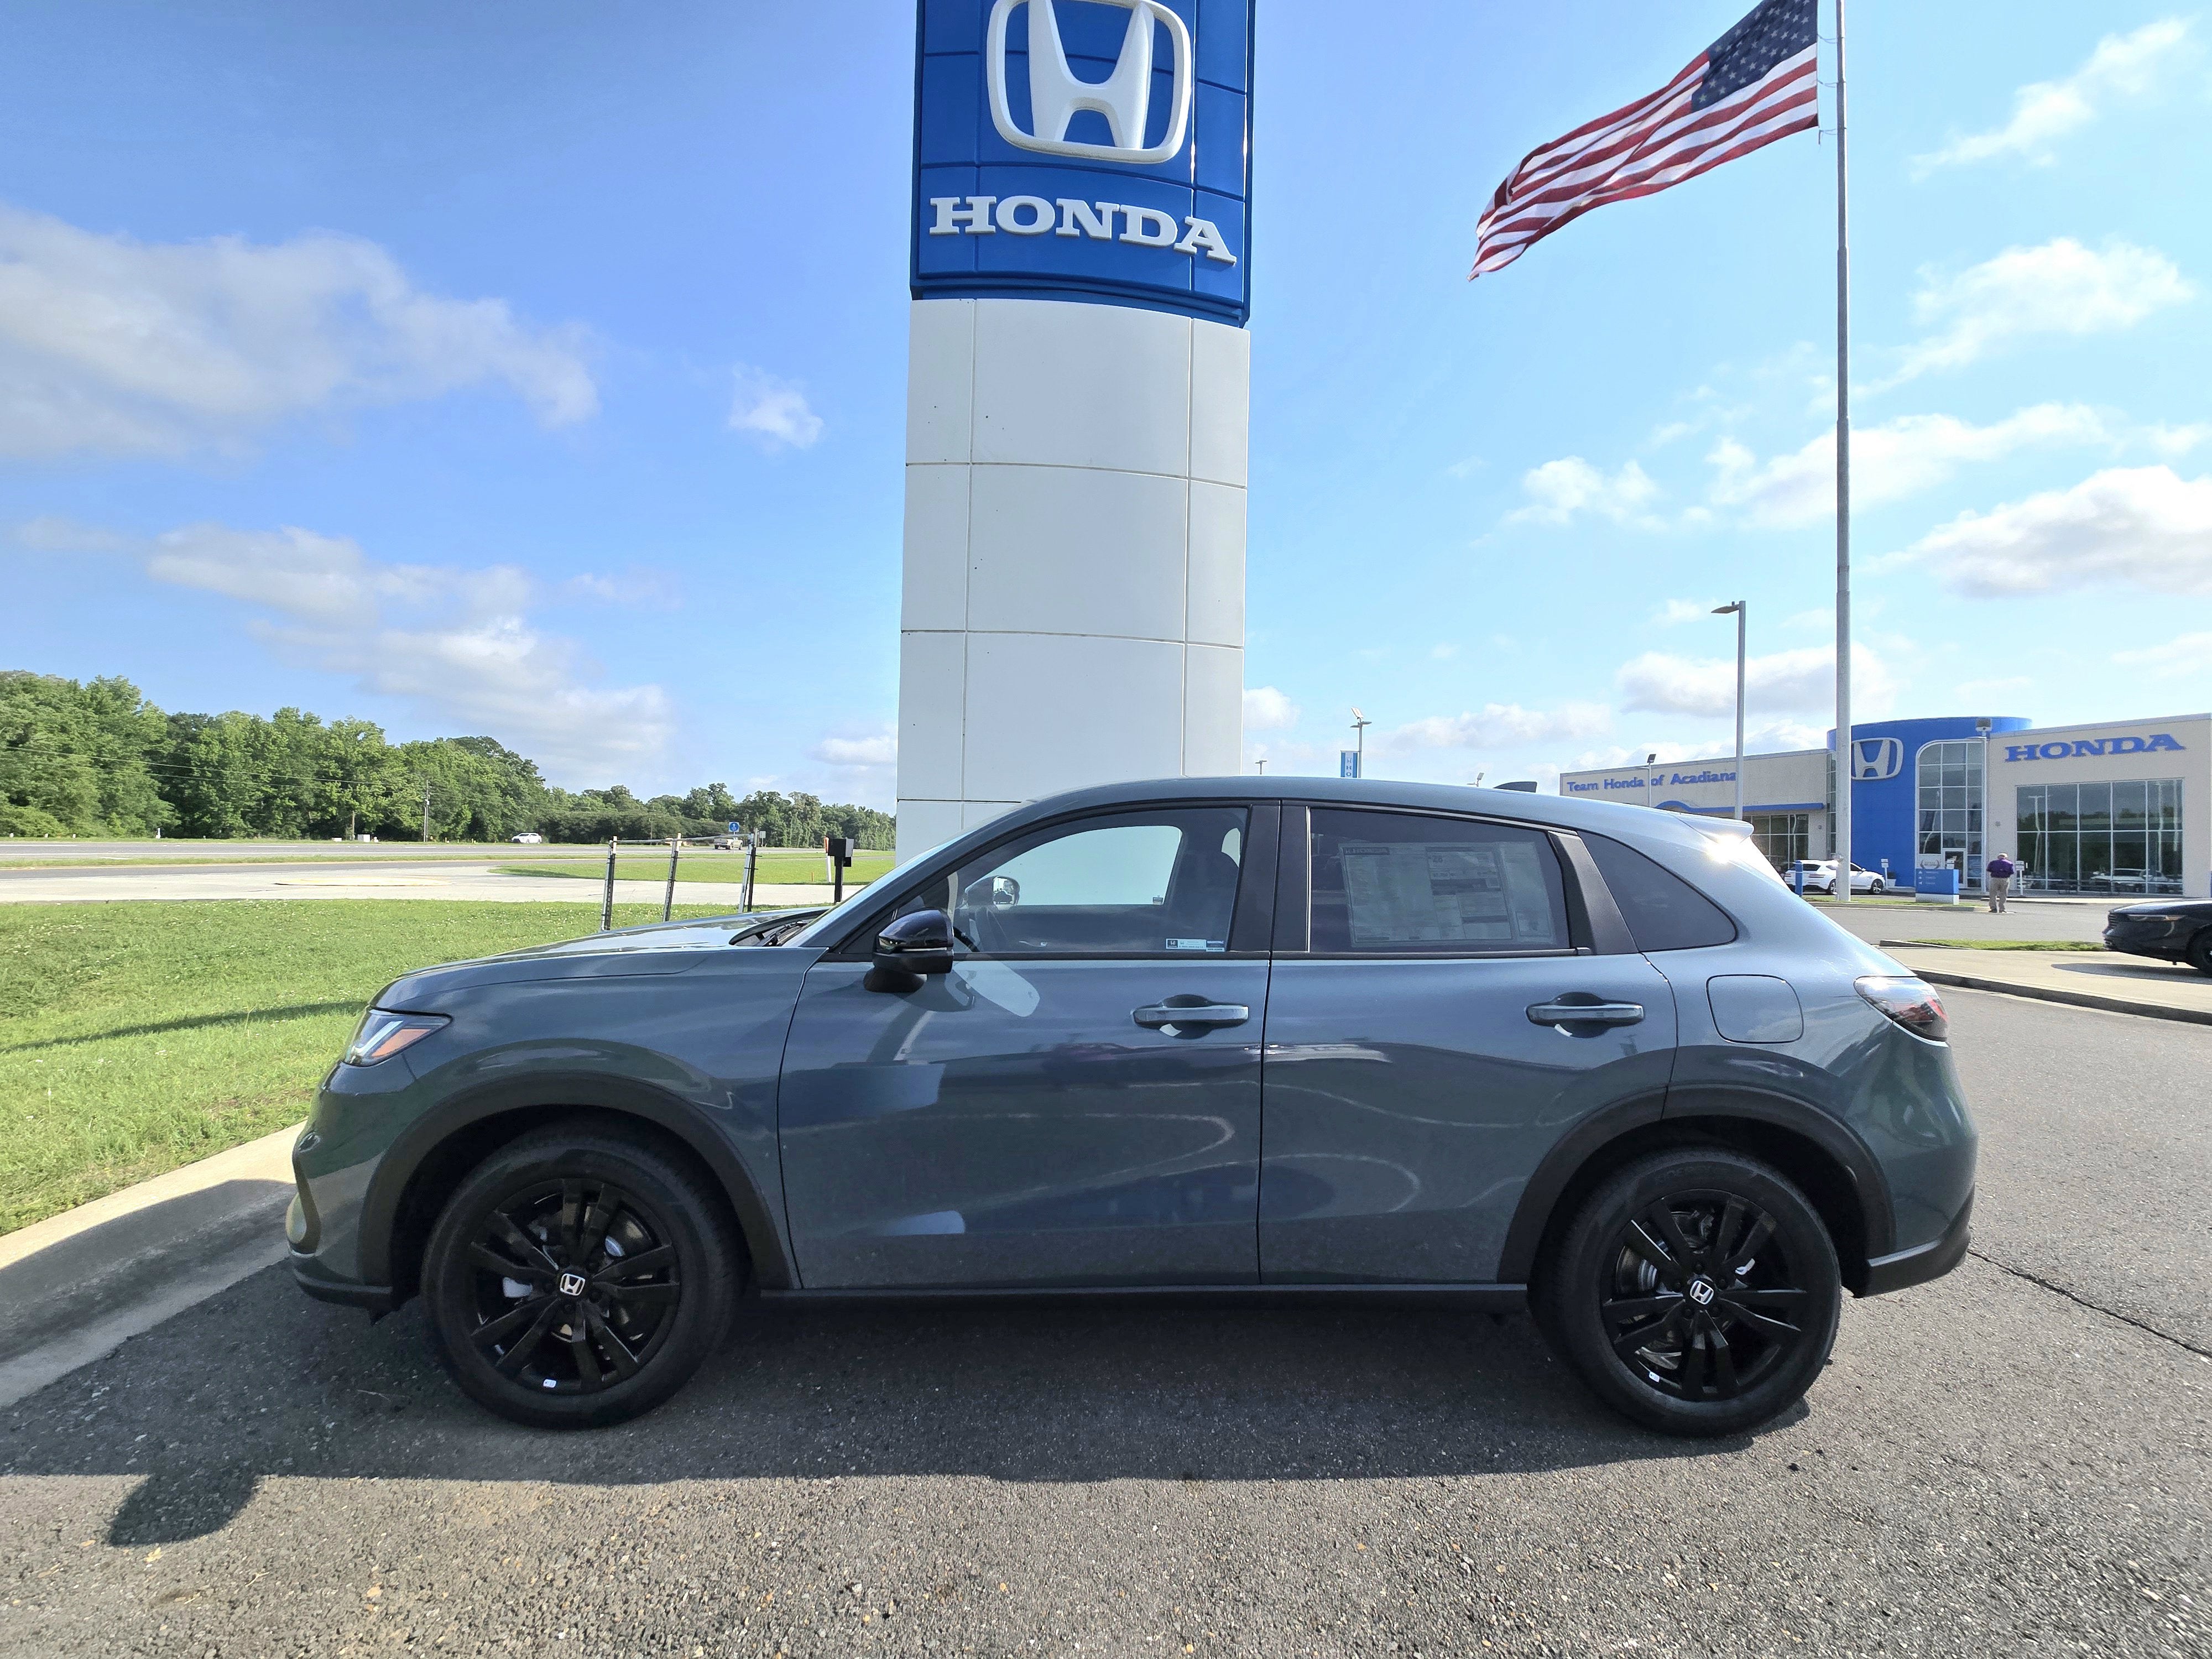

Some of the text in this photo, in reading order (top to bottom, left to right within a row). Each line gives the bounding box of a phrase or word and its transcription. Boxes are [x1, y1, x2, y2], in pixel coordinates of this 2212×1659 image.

[929, 195, 1237, 264] HONDA
[2005, 734, 2185, 762] HONDA
[1567, 771, 1736, 791] Team Honda of Acadiana
